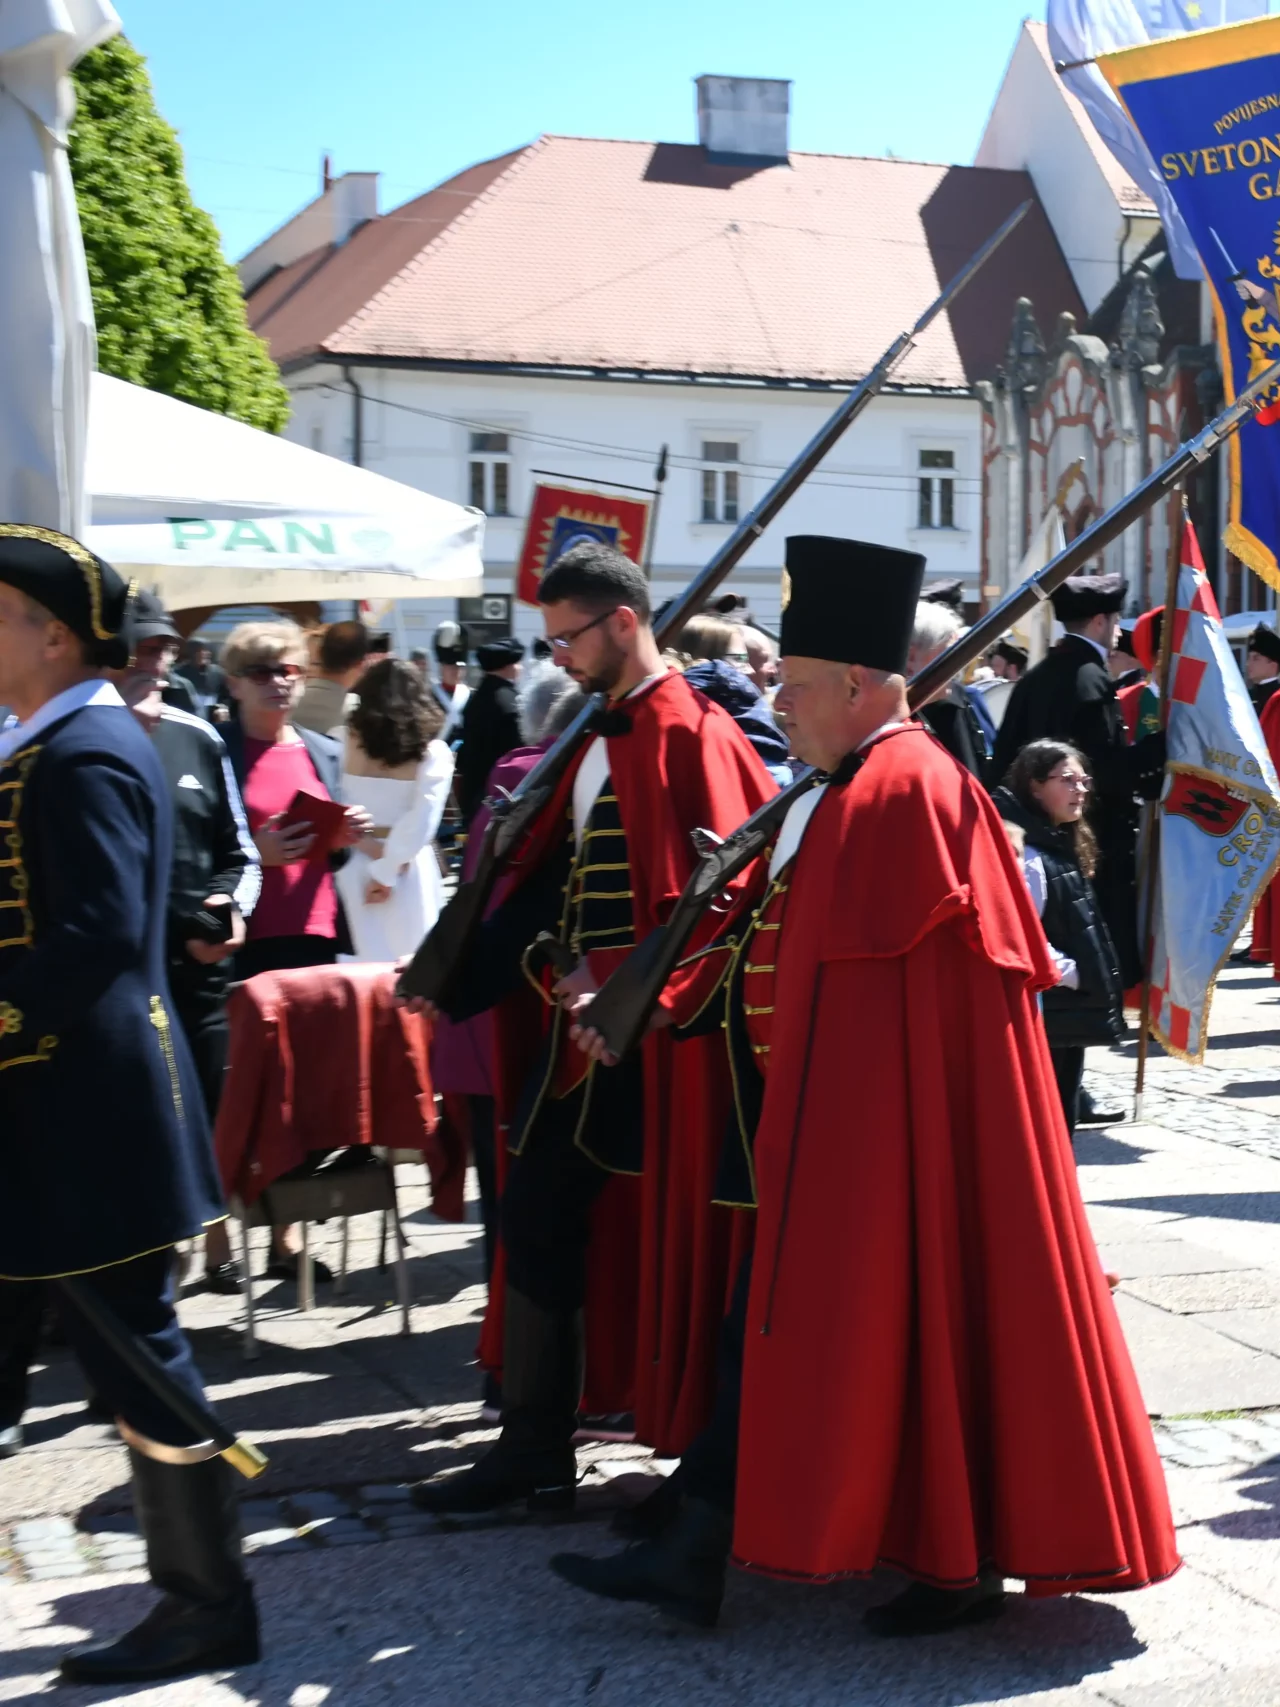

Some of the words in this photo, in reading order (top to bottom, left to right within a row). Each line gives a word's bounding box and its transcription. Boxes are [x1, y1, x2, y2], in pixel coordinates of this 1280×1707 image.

[164, 516, 337, 555] PAN
[1210, 891, 1245, 937] NAVIK
[1237, 864, 1259, 889] ON
